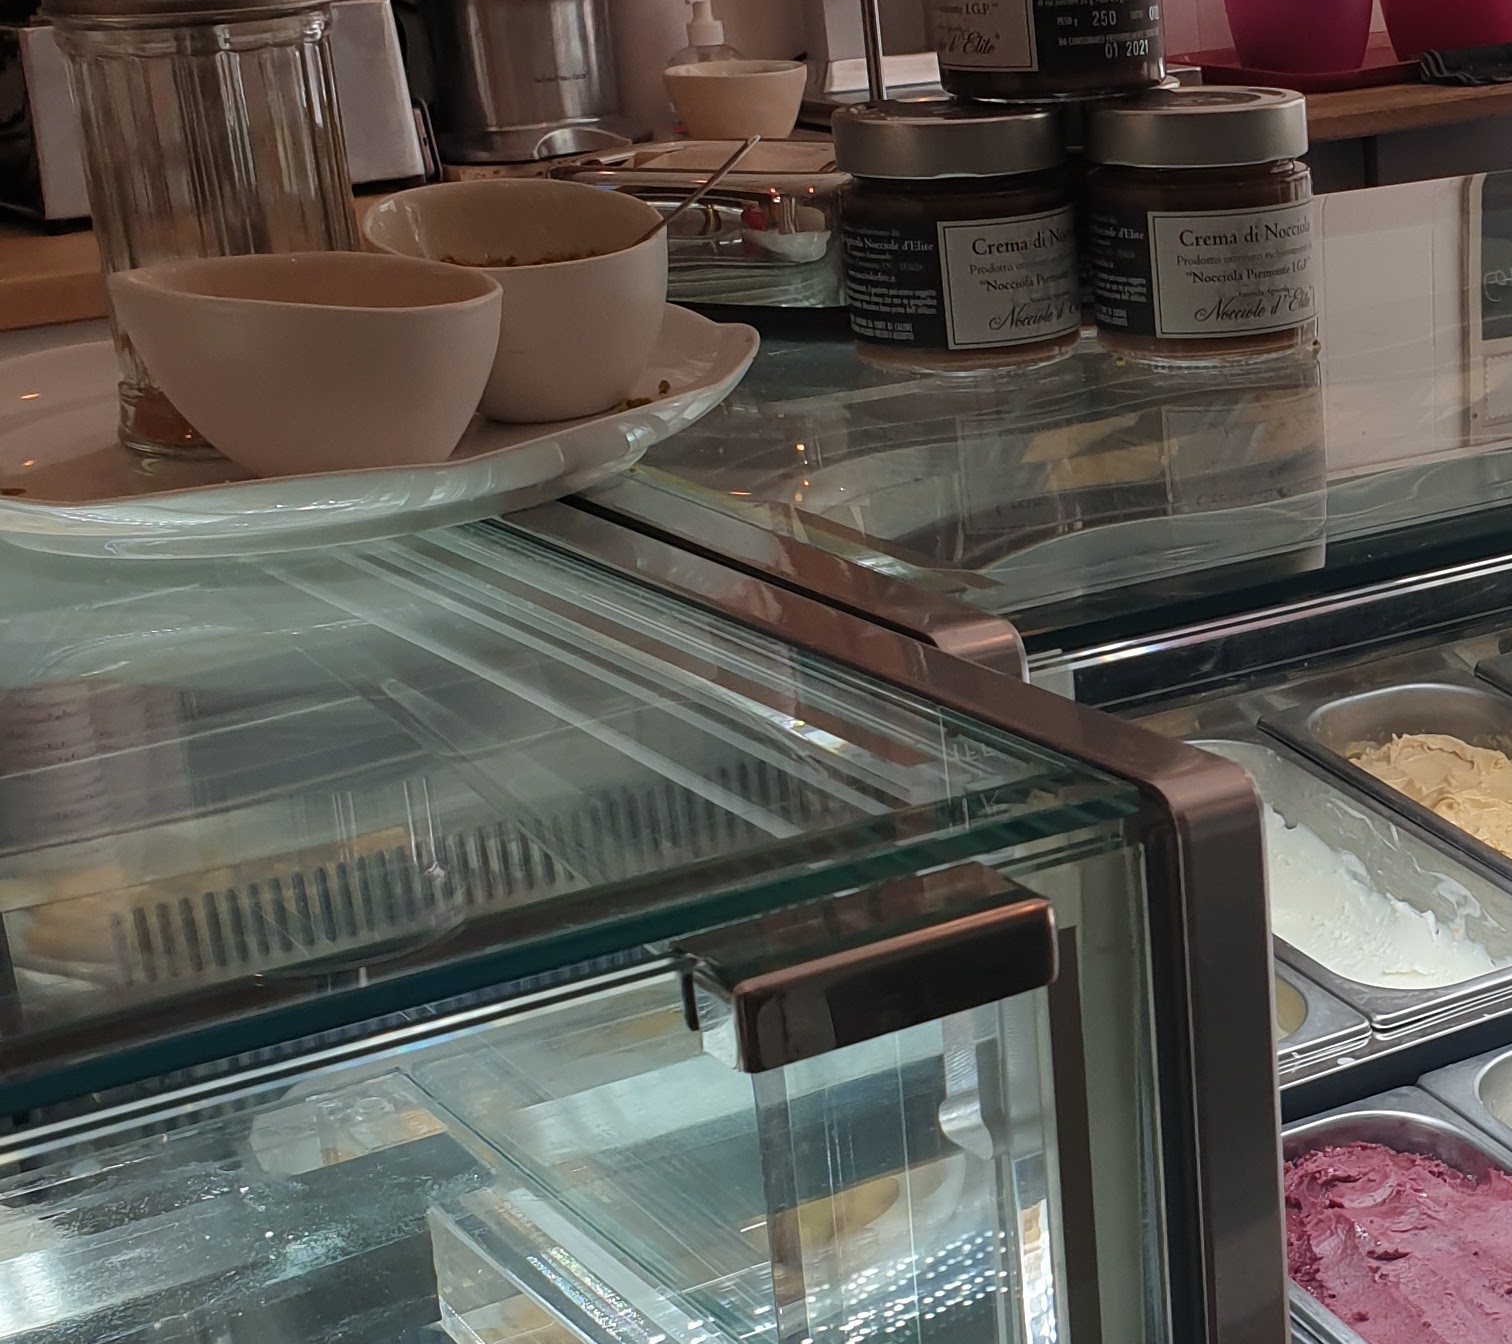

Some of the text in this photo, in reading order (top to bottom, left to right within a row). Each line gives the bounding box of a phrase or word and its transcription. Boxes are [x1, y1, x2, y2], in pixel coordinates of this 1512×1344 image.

[1092, 10, 1117, 26] 250
[1126, 39, 1149, 58] 2021
[1179, 216, 1310, 247] Crema di Nocciola
[972, 237, 1029, 256] Crema
[1033, 231, 1047, 248] di
[969, 263, 1014, 276] Prodotto
[1176, 255, 1222, 267] Prodotto
